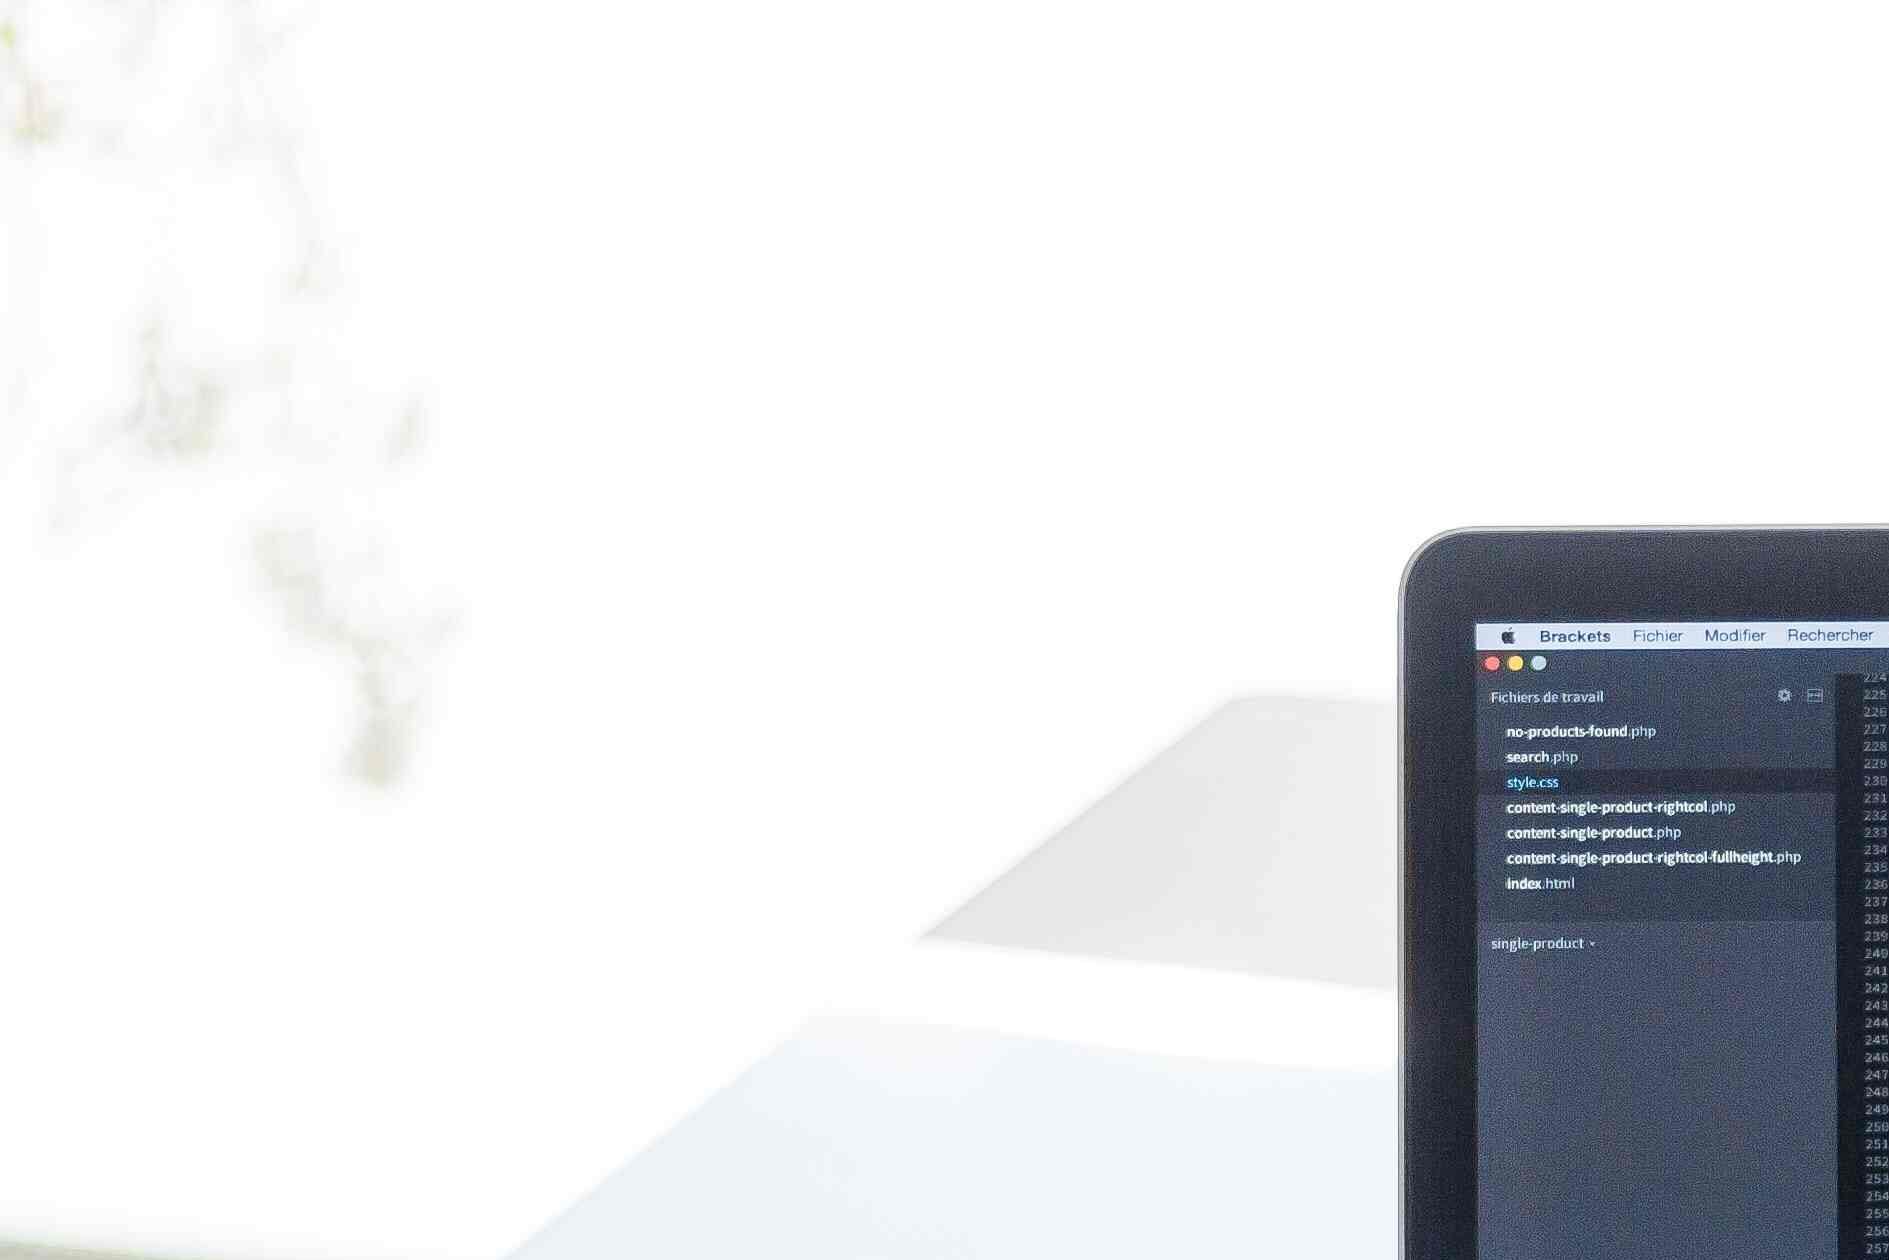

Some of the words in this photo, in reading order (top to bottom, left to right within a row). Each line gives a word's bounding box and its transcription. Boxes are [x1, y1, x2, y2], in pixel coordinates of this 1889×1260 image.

[1541, 631, 1610, 642] Brackets
[1633, 630, 1683, 642] Fichier
[1705, 629, 1765, 641] Modifier
[1788, 629, 1874, 641] Rechercher
[1491, 692, 1540, 703] Fichiers
[1542, 691, 1558, 703] de
[1562, 691, 1603, 703] travail
[1507, 725, 1656, 740] no-products-found.php
[1506, 751, 1578, 765] search.php
[1507, 776, 1558, 791] style.css
[1506, 800, 1735, 816] content-single-product-rightcol.php
[1507, 826, 1681, 841] content-single-product.php
[1506, 850, 1801, 867] content-single-product-rightcol-fullheight.php
[1506, 877, 1574, 889] index.html
[1491, 937, 1584, 952] single-product
